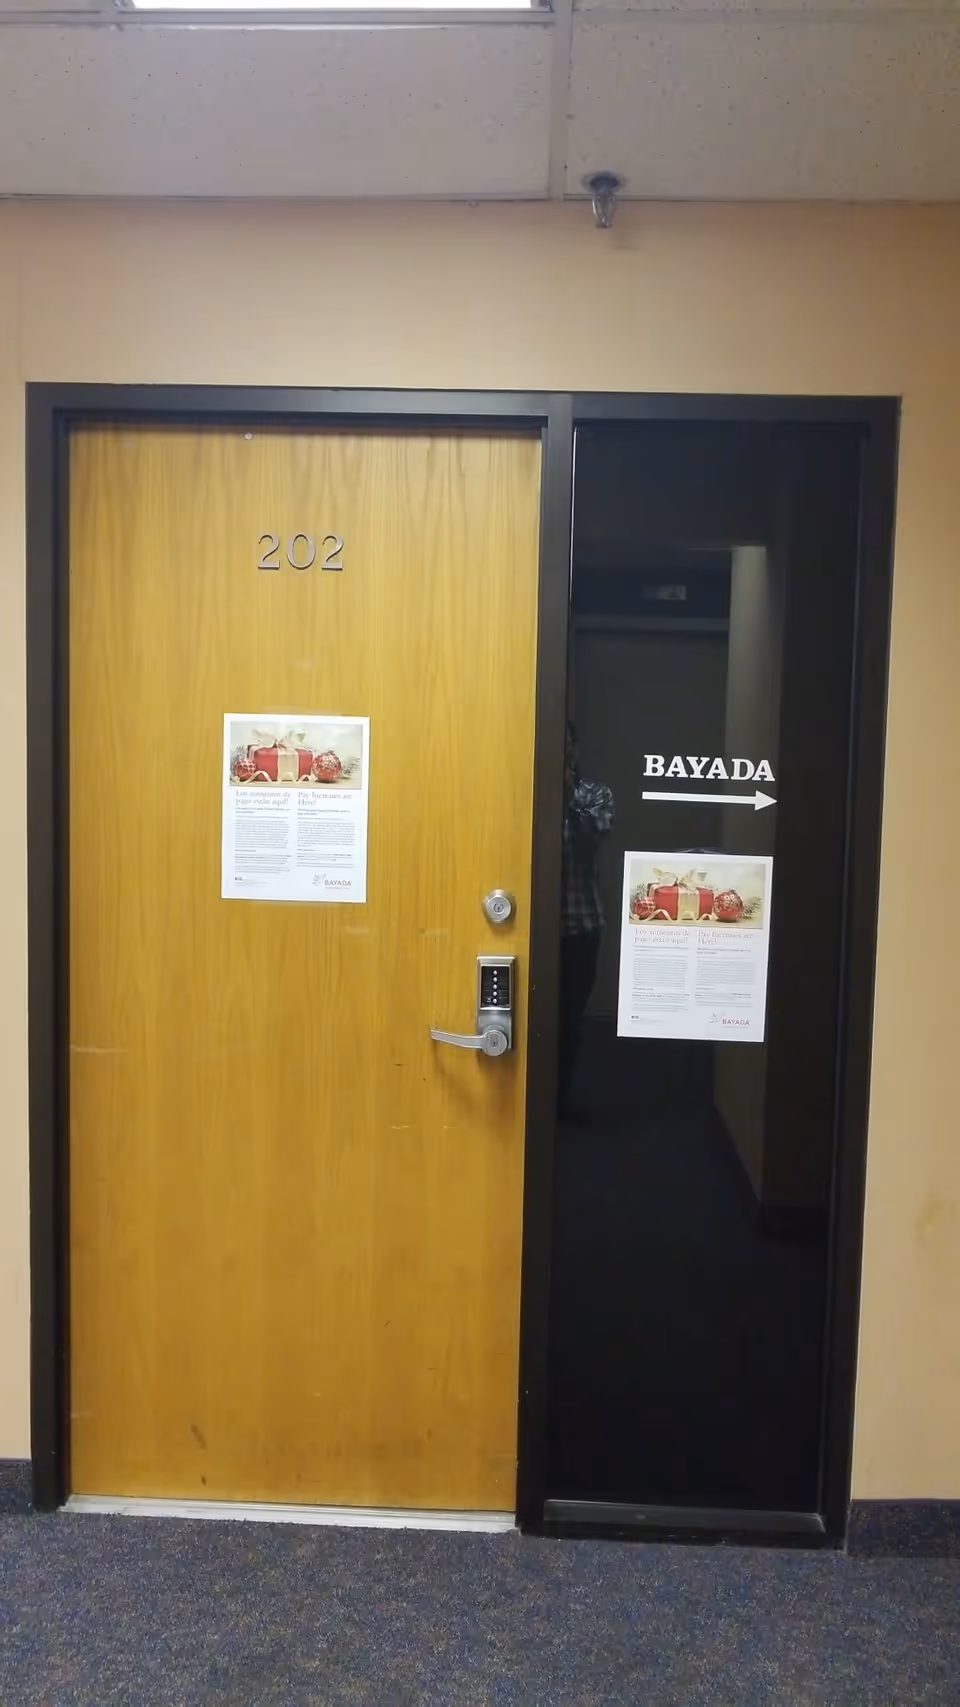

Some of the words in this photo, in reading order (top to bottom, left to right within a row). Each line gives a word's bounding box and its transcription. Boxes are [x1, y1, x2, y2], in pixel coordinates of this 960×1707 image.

[257, 532, 344, 571] 202
[643, 754, 776, 782] BAYADA
[324, 879, 352, 887] BAYADA
[722, 1018, 750, 1026] BAYADA
